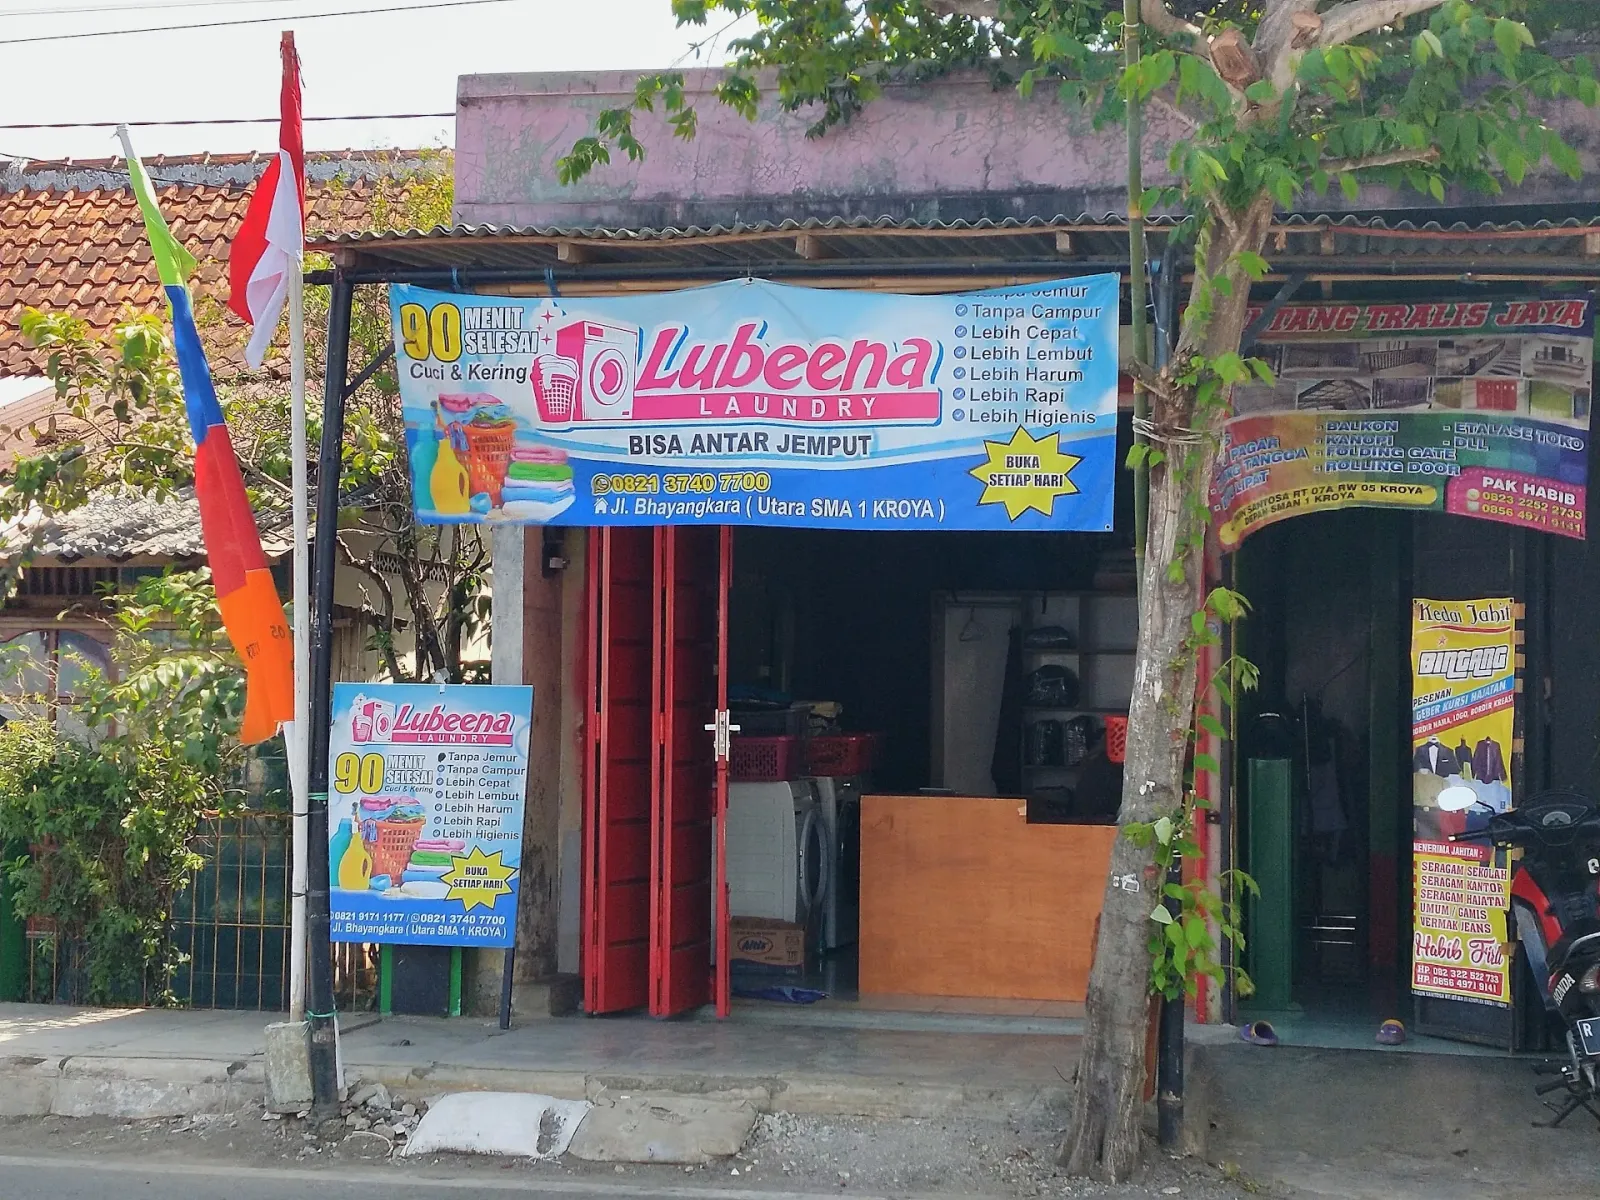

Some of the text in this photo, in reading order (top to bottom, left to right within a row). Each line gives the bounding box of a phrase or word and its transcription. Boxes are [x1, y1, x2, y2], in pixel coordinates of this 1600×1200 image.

[464, 307, 524, 330] MENIT
[972, 304, 1101, 321] Tanpa Campur
[1363, 302, 1492, 331] TRALIS
[1495, 299, 1589, 329] JAYA
[400, 303, 462, 363] 90
[971, 325, 1078, 343] Lebih Cepat
[465, 330, 539, 355] SELESAI
[637, 323, 938, 393] Lubeena
[970, 345, 1093, 361] Lebih Lembut
[410, 362, 527, 384] Cuci & Kering
[970, 366, 1083, 382] Lebih Harum
[969, 387, 1065, 405] Lebih Rapi
[699, 396, 877, 417] LAUNDRY
[969, 408, 1096, 427] Lebih Higienis
[1325, 420, 1399, 433] BALKON
[629, 432, 872, 456] BISA ANTAR JEMPUT
[1325, 434, 1394, 447] KANOPI
[1454, 421, 1585, 451] ETALASE TOKO
[1454, 436, 1489, 451] DLL
[1230, 437, 1280, 461] PAGAR
[1325, 447, 1457, 461] FOLDING GATE
[1006, 455, 1040, 469] BUKA
[1244, 447, 1309, 472] TANGGA
[1325, 460, 1461, 476] ROLLING DOOR
[611, 472, 771, 494] 0821 3740 7700
[989, 473, 1063, 487] SETIAP HARI
[1247, 493, 1289, 513] SANTOSA
[1293, 488, 1307, 498] RT
[1338, 483, 1357, 493] RW
[1361, 484, 1376, 493] 05
[1380, 485, 1423, 495] KROYA
[1482, 476, 1576, 505] PAK HABIB
[611, 498, 629, 515] Jl.
[635, 497, 740, 518] Bhayangkara
[758, 499, 806, 517] Utara
[810, 499, 853, 518] SMA
[858, 499, 867, 518] 1
[872, 499, 935, 518] KROYA
[1271, 498, 1301, 514] SMAN
[1314, 492, 1355, 504] KROYA
[1482, 491, 1583, 520] 0823 2252 2733
[1482, 503, 1513, 517] 0856
[1418, 602, 1511, 624] Kedai Jahit
[1416, 680, 1506, 720] GEBER KURSI HAJATAN
[393, 704, 512, 733] Lubeena
[417, 733, 489, 744] LAUNDRY
[387, 754, 425, 769] MENIT
[448, 752, 518, 763] Tanpa Jemur
[334, 752, 385, 794] 90
[386, 770, 433, 785] SELESAI
[447, 765, 525, 777] Tanpa Campur
[384, 785, 401, 793] Cuci
[409, 786, 434, 795] Kering
[446, 778, 511, 789] Lebih Cepat
[445, 790, 519, 801] Lebih Lembut
[444, 803, 513, 814] Lebih Harum
[443, 816, 501, 828] Lebih Rapi
[442, 829, 519, 842] Lebih Higienis
[465, 866, 488, 876] BUKA
[1421, 861, 1507, 880] SERAGAM SEKOLAH
[453, 878, 503, 889] SETIAP HARI
[1421, 875, 1504, 893] SERAGAM KANTOR
[1420, 889, 1463, 903] SERAGAM
[335, 911, 356, 921] 0821
[359, 912, 380, 921] 9171
[382, 913, 404, 922] 1177
[420, 913, 446, 923] 0821
[449, 914, 476, 924] 3740
[479, 915, 505, 925] 7700
[1420, 903, 1449, 915] UMUM
[1458, 908, 1487, 919] GAMIS
[345, 922, 403, 936] Bhayangkara
[411, 924, 435, 935] Utara
[437, 925, 458, 936] SMA
[460, 925, 466, 936] 1
[468, 926, 501, 937] KROYA
[1420, 916, 1491, 933] VERMAK JEANS
[1415, 932, 1462, 960] Habib
[1450, 969, 1467, 979] 322
[1456, 980, 1476, 989] 4971
[1479, 983, 1496, 992] 9141
[1553, 972, 1576, 1007] HONDA
[1582, 1022, 1593, 1037] R
